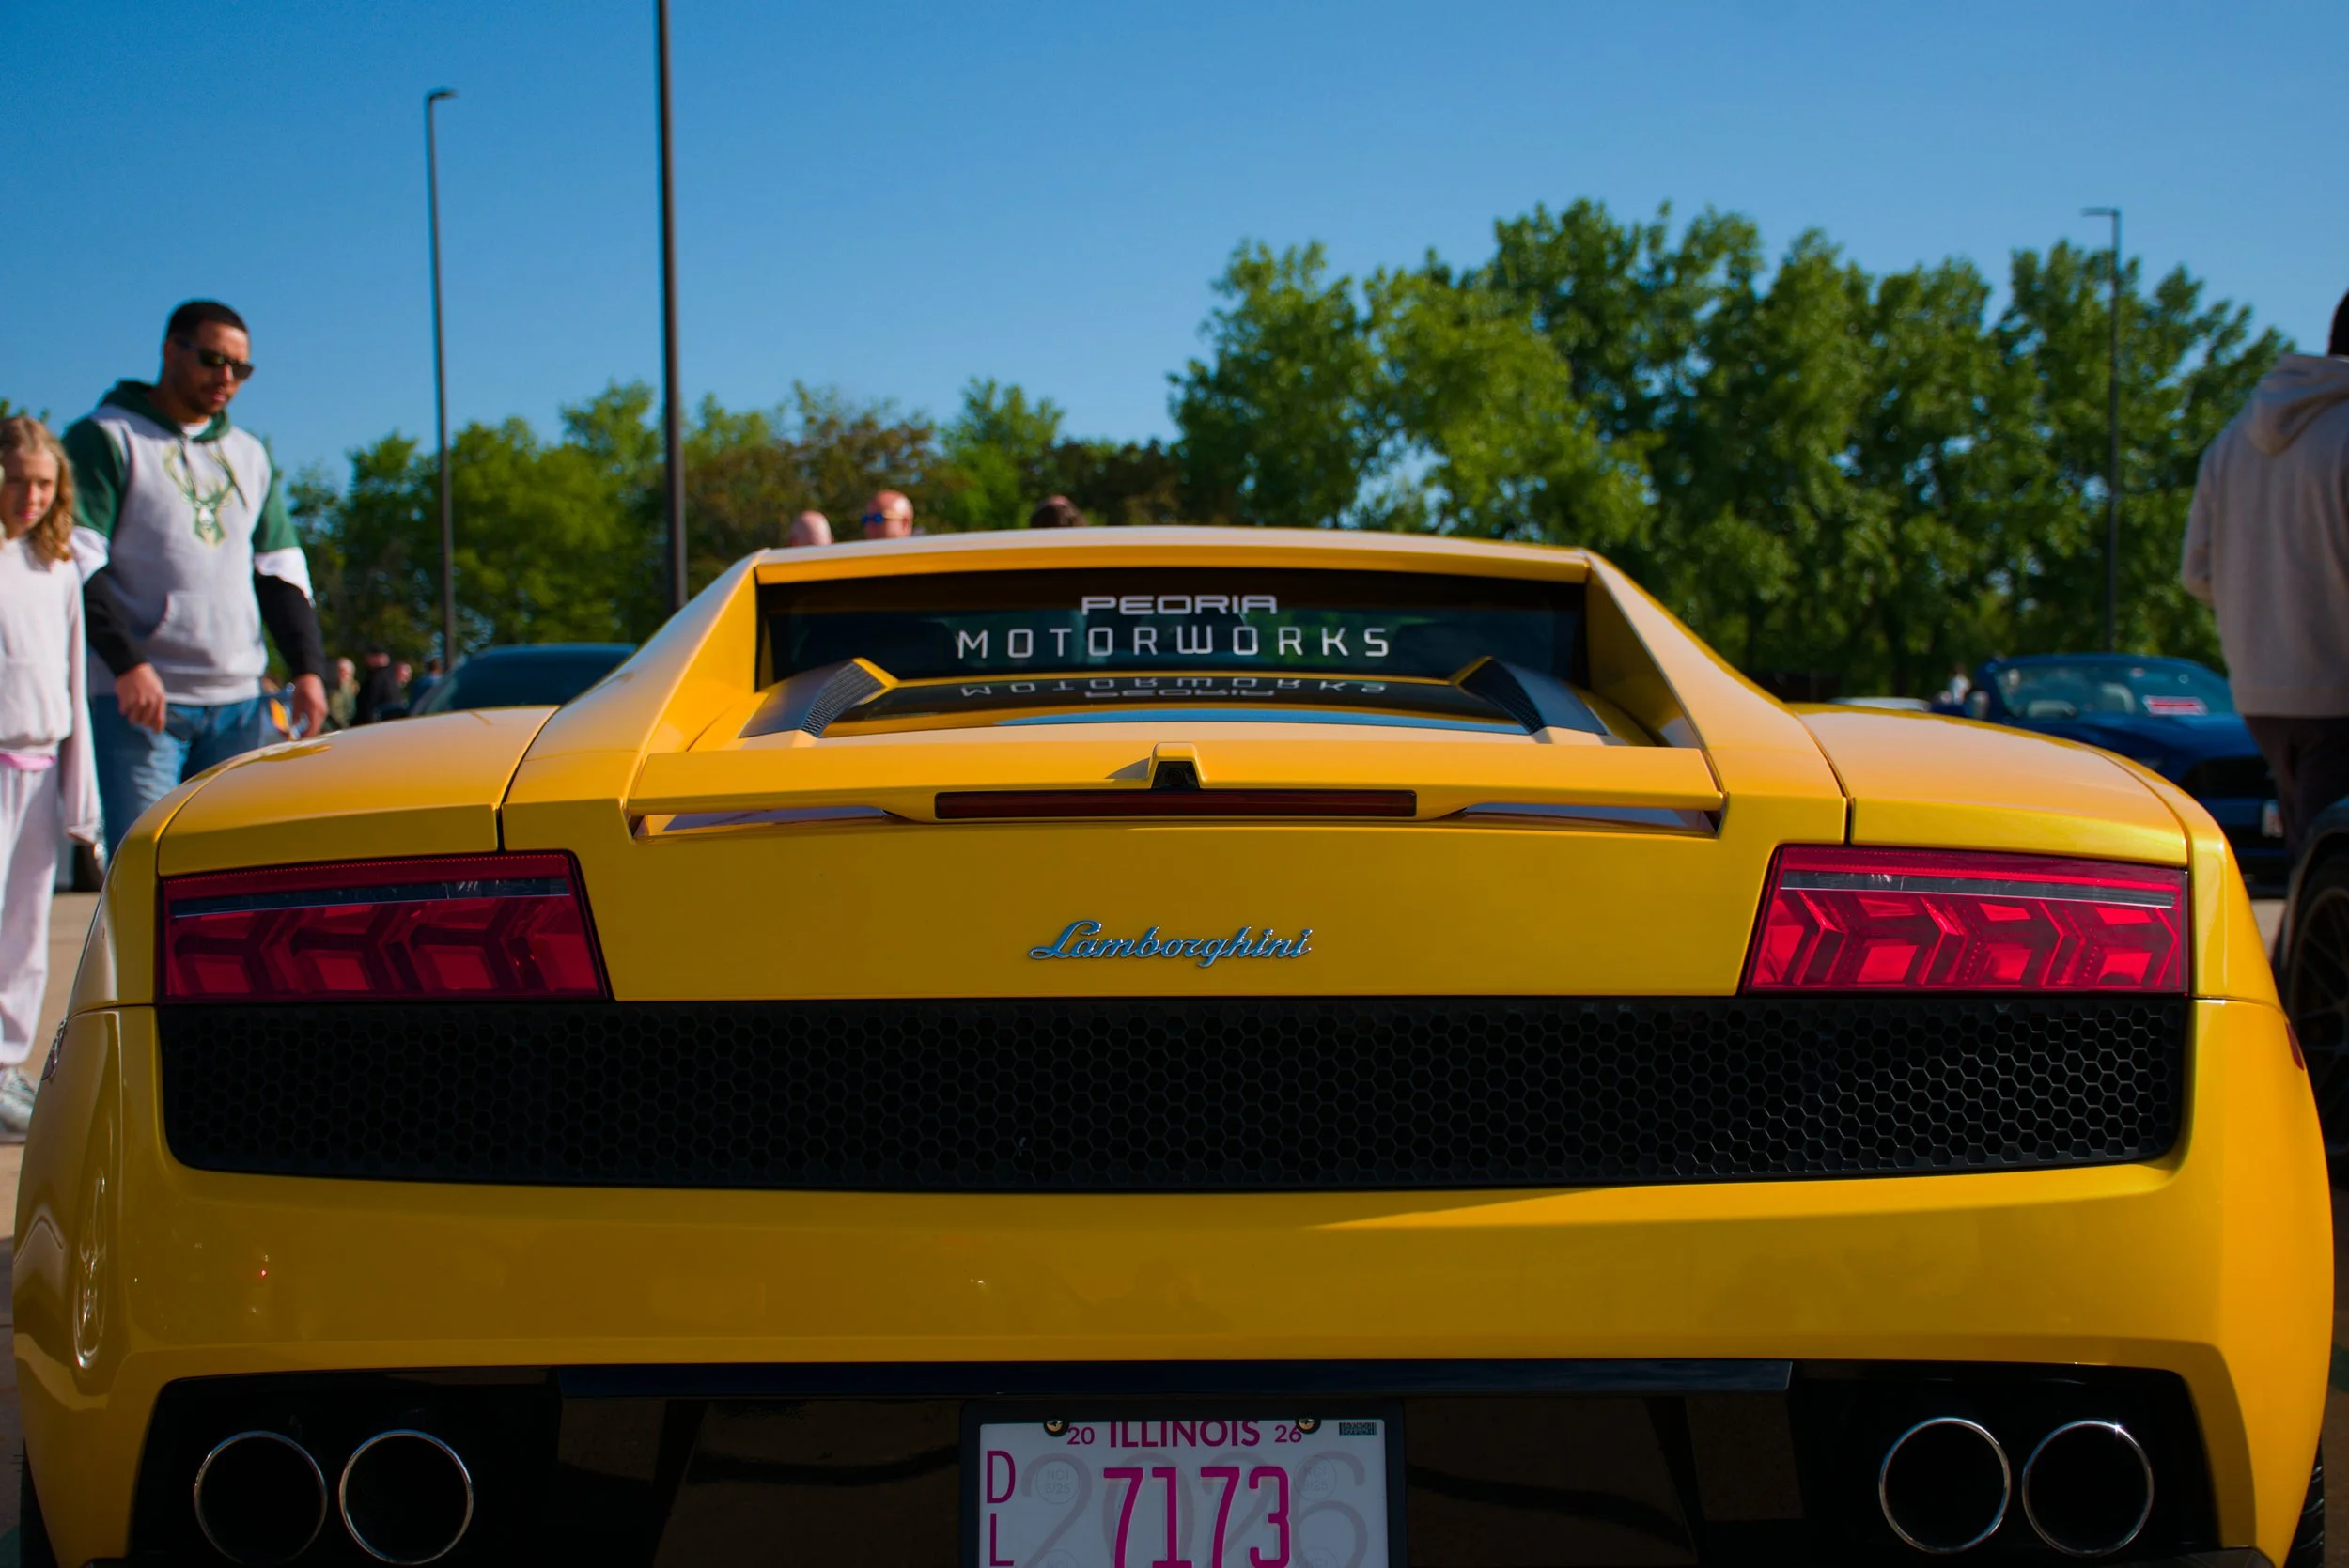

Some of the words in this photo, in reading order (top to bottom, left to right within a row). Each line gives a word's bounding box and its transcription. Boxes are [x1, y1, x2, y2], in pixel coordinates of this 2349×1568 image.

[1081, 595, 1278, 615] PEORIA
[957, 625, 1390, 659] MOTORWORKS
[1029, 920, 1313, 968] Lamborghini
[1067, 1426, 1095, 1445] 20
[1110, 1421, 1260, 1448] ILLINOIS
[1274, 1425, 1302, 1443] 26
[1103, 1466, 1290, 1568] 7173
